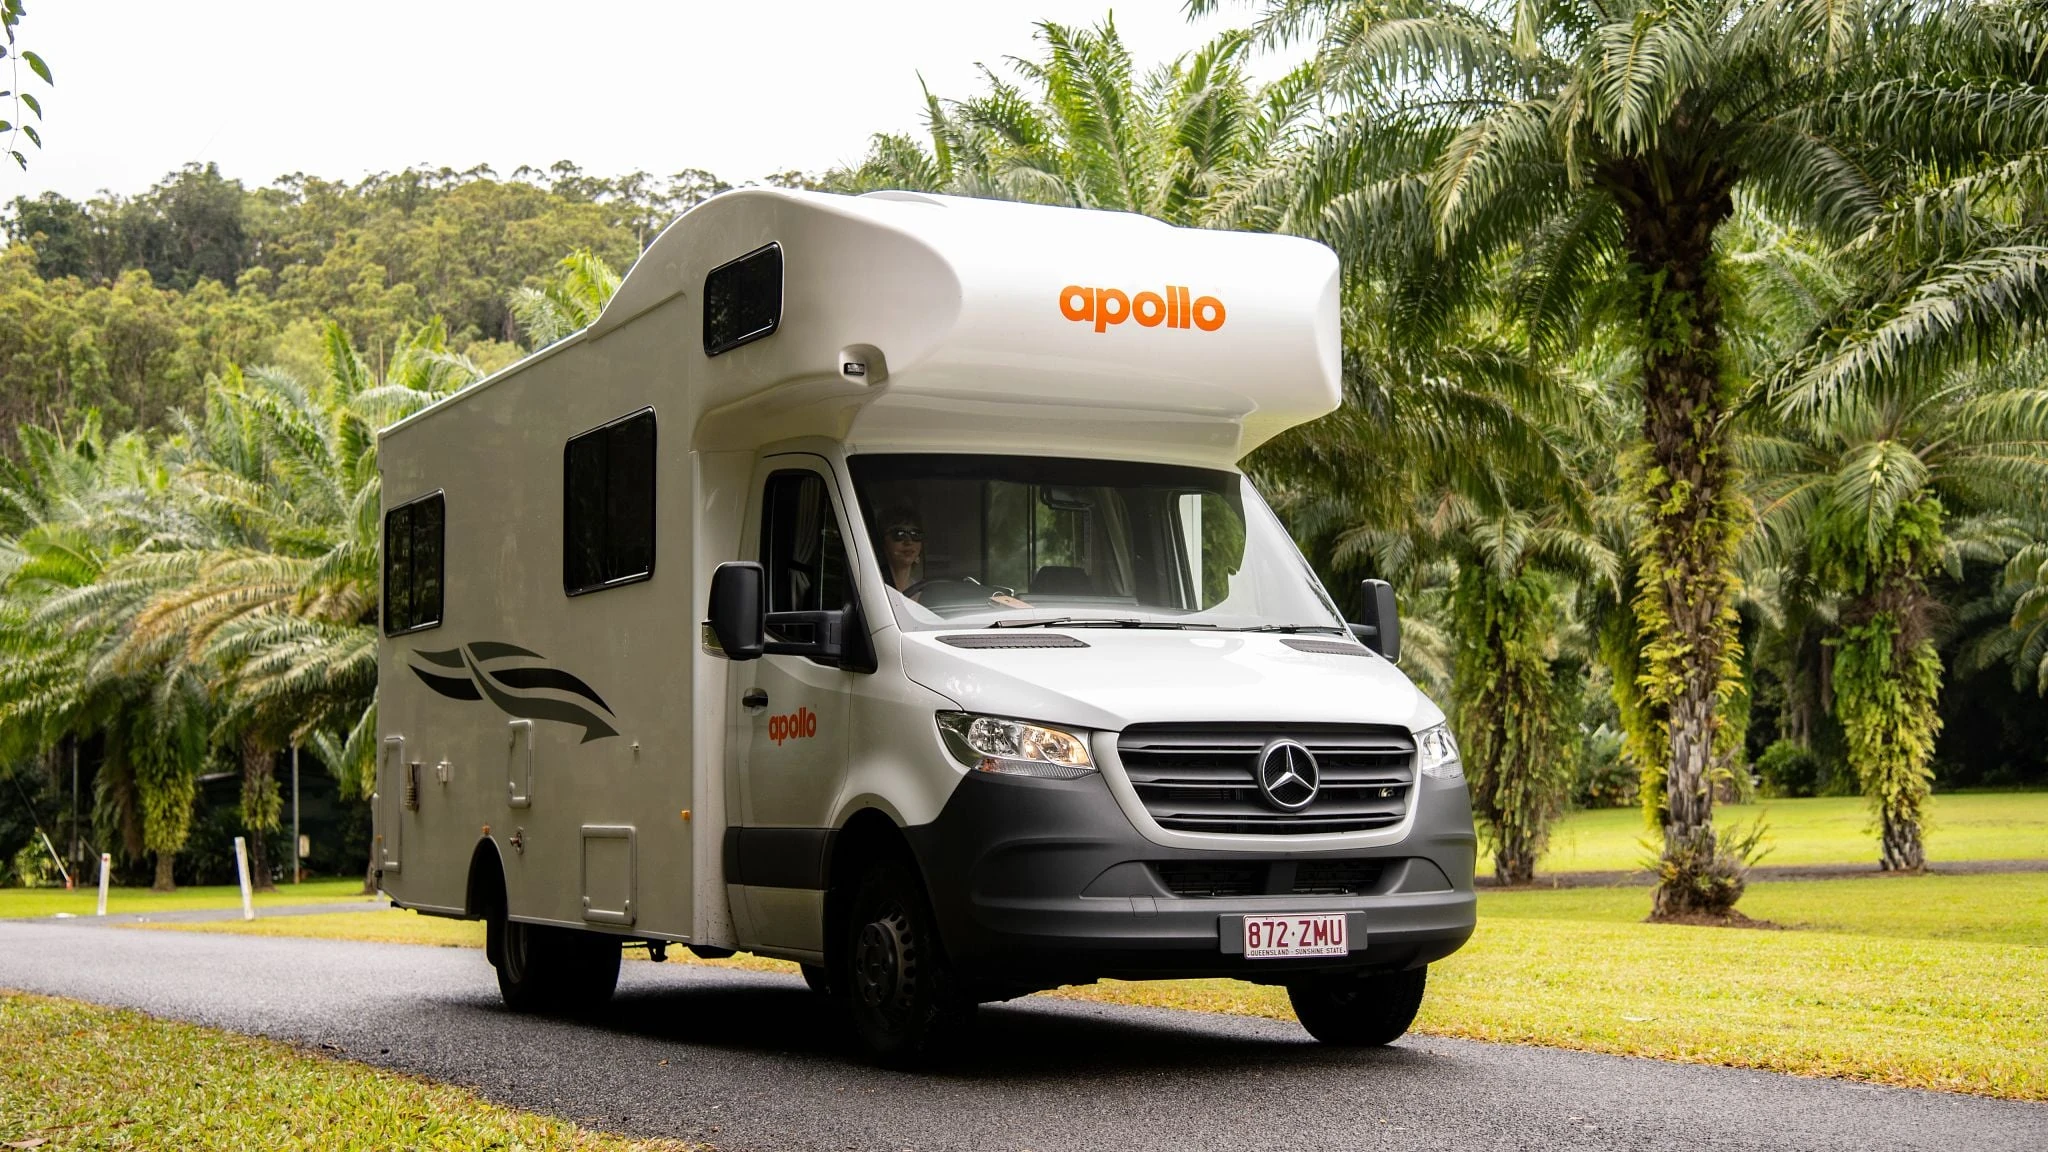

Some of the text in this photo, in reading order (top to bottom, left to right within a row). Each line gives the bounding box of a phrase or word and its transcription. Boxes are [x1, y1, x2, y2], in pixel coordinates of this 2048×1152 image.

[1059, 285, 1226, 333] apollo
[769, 707, 816, 746] apollo
[1295, 947, 1324, 955] SUNSHINE
